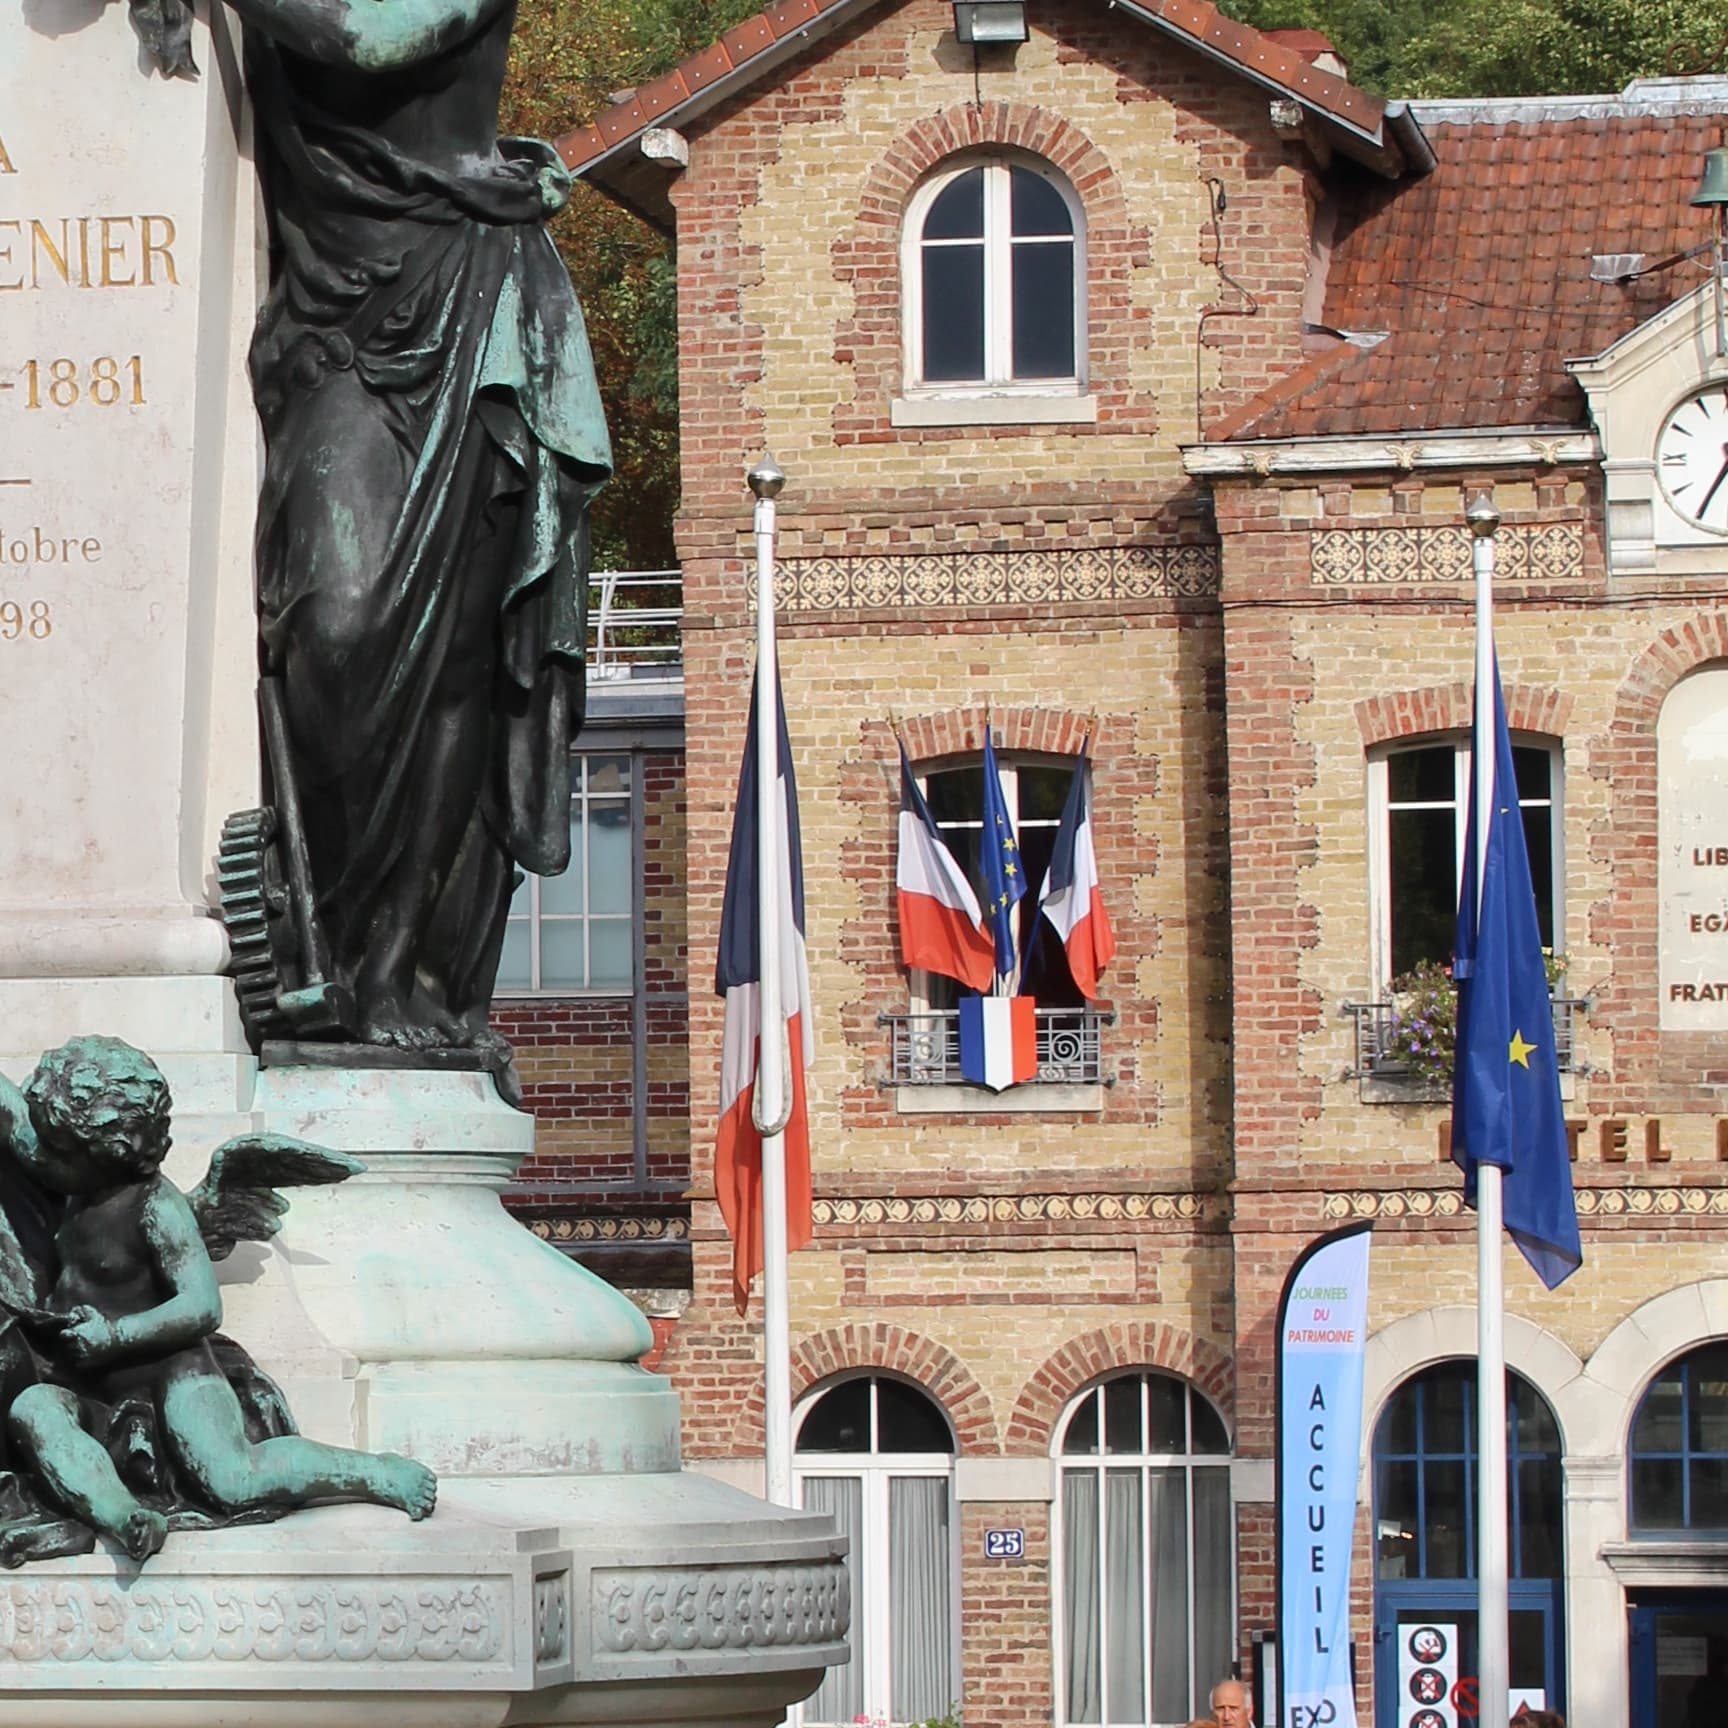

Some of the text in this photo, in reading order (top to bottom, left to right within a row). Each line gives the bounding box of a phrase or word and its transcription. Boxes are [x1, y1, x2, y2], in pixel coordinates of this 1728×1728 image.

[1689, 913, 1728, 933] EG
[1313, 1308, 1330, 1322] DU
[1287, 1329, 1355, 1343] PATRIMOINE
[1308, 1383, 1329, 1654] ACCUEIL
[990, 1532, 1020, 1554] 25
